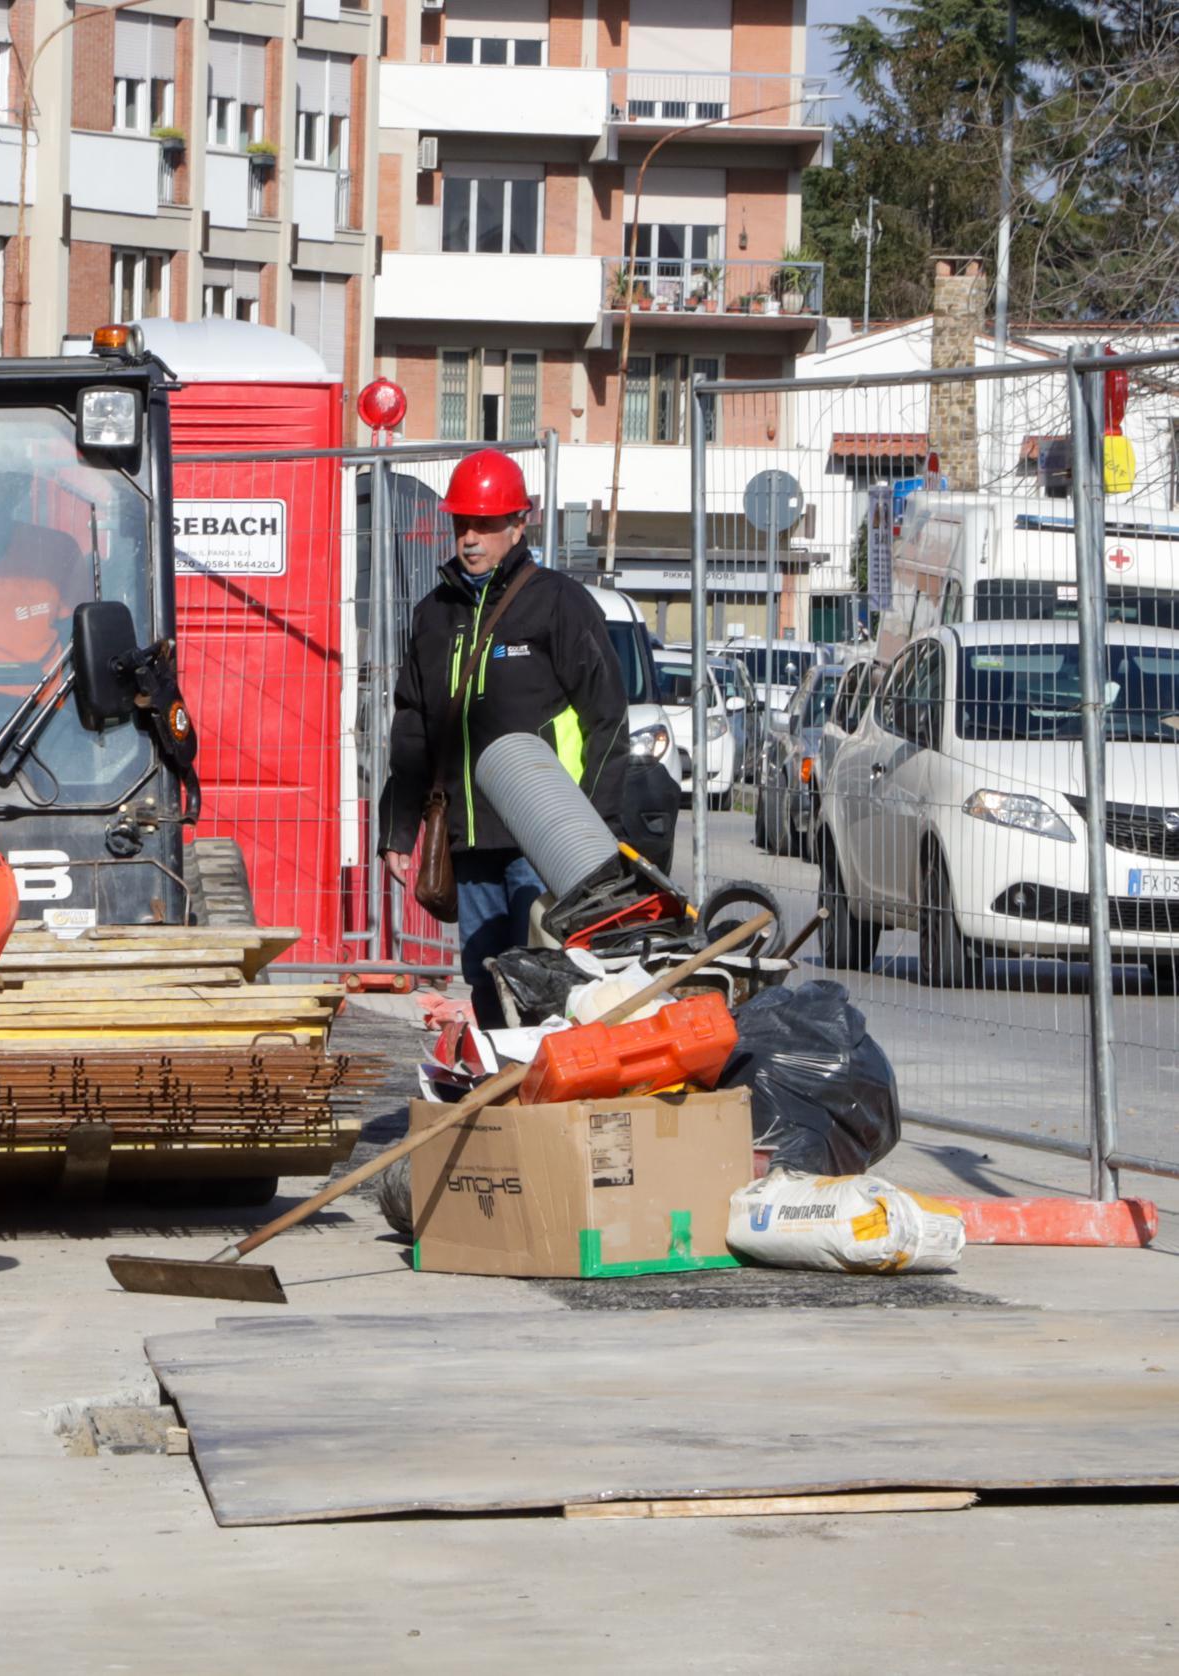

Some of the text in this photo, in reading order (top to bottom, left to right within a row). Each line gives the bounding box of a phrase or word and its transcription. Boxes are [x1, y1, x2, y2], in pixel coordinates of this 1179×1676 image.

[204, 560, 230, 569] 0584
[233, 560, 276, 569] 1644204
[1142, 875, 1159, 892] FX
